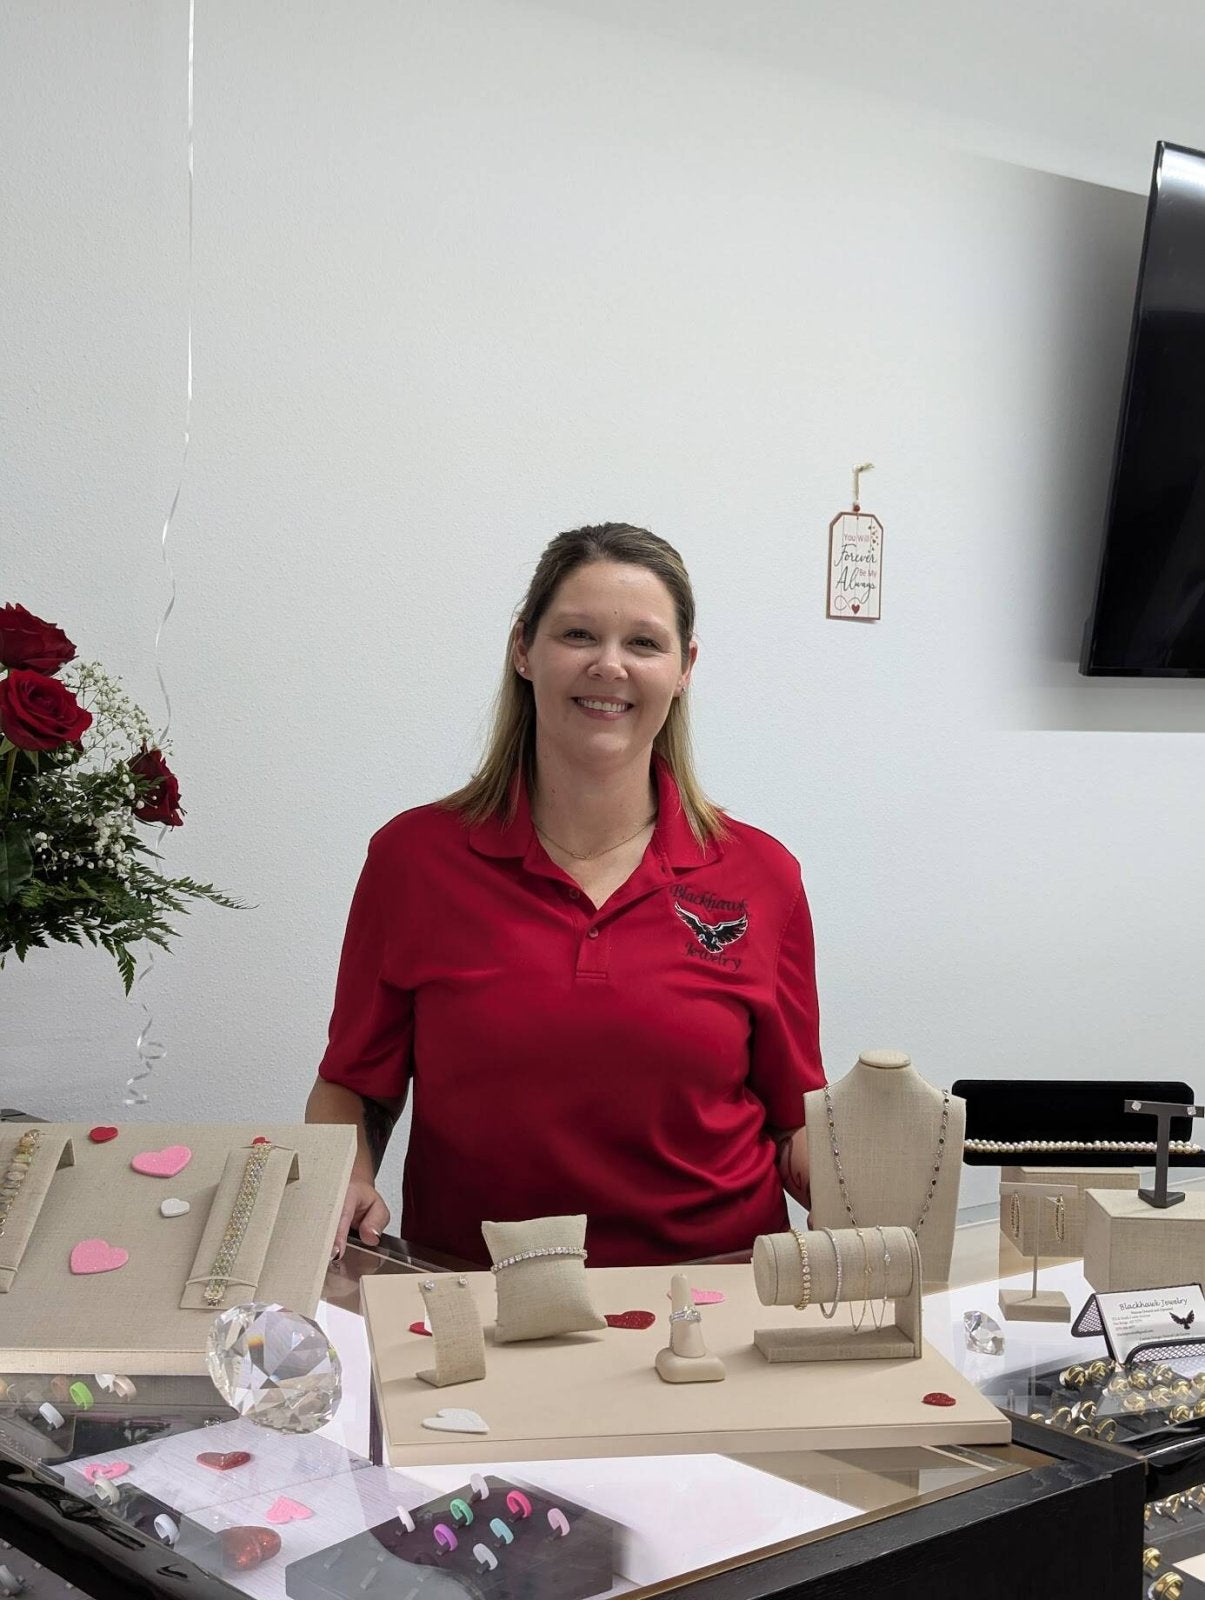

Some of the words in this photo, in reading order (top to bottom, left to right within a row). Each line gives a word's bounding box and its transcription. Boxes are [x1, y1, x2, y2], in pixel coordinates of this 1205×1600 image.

[844, 534, 856, 543] You
[834, 543, 877, 567] Forever
[835, 566, 876, 602] Always
[671, 884, 748, 913] Blackhawk
[686, 942, 742, 971] Jewelry
[1119, 1299, 1161, 1311] Blackhawk
[1161, 1297, 1188, 1309] Jewelry
